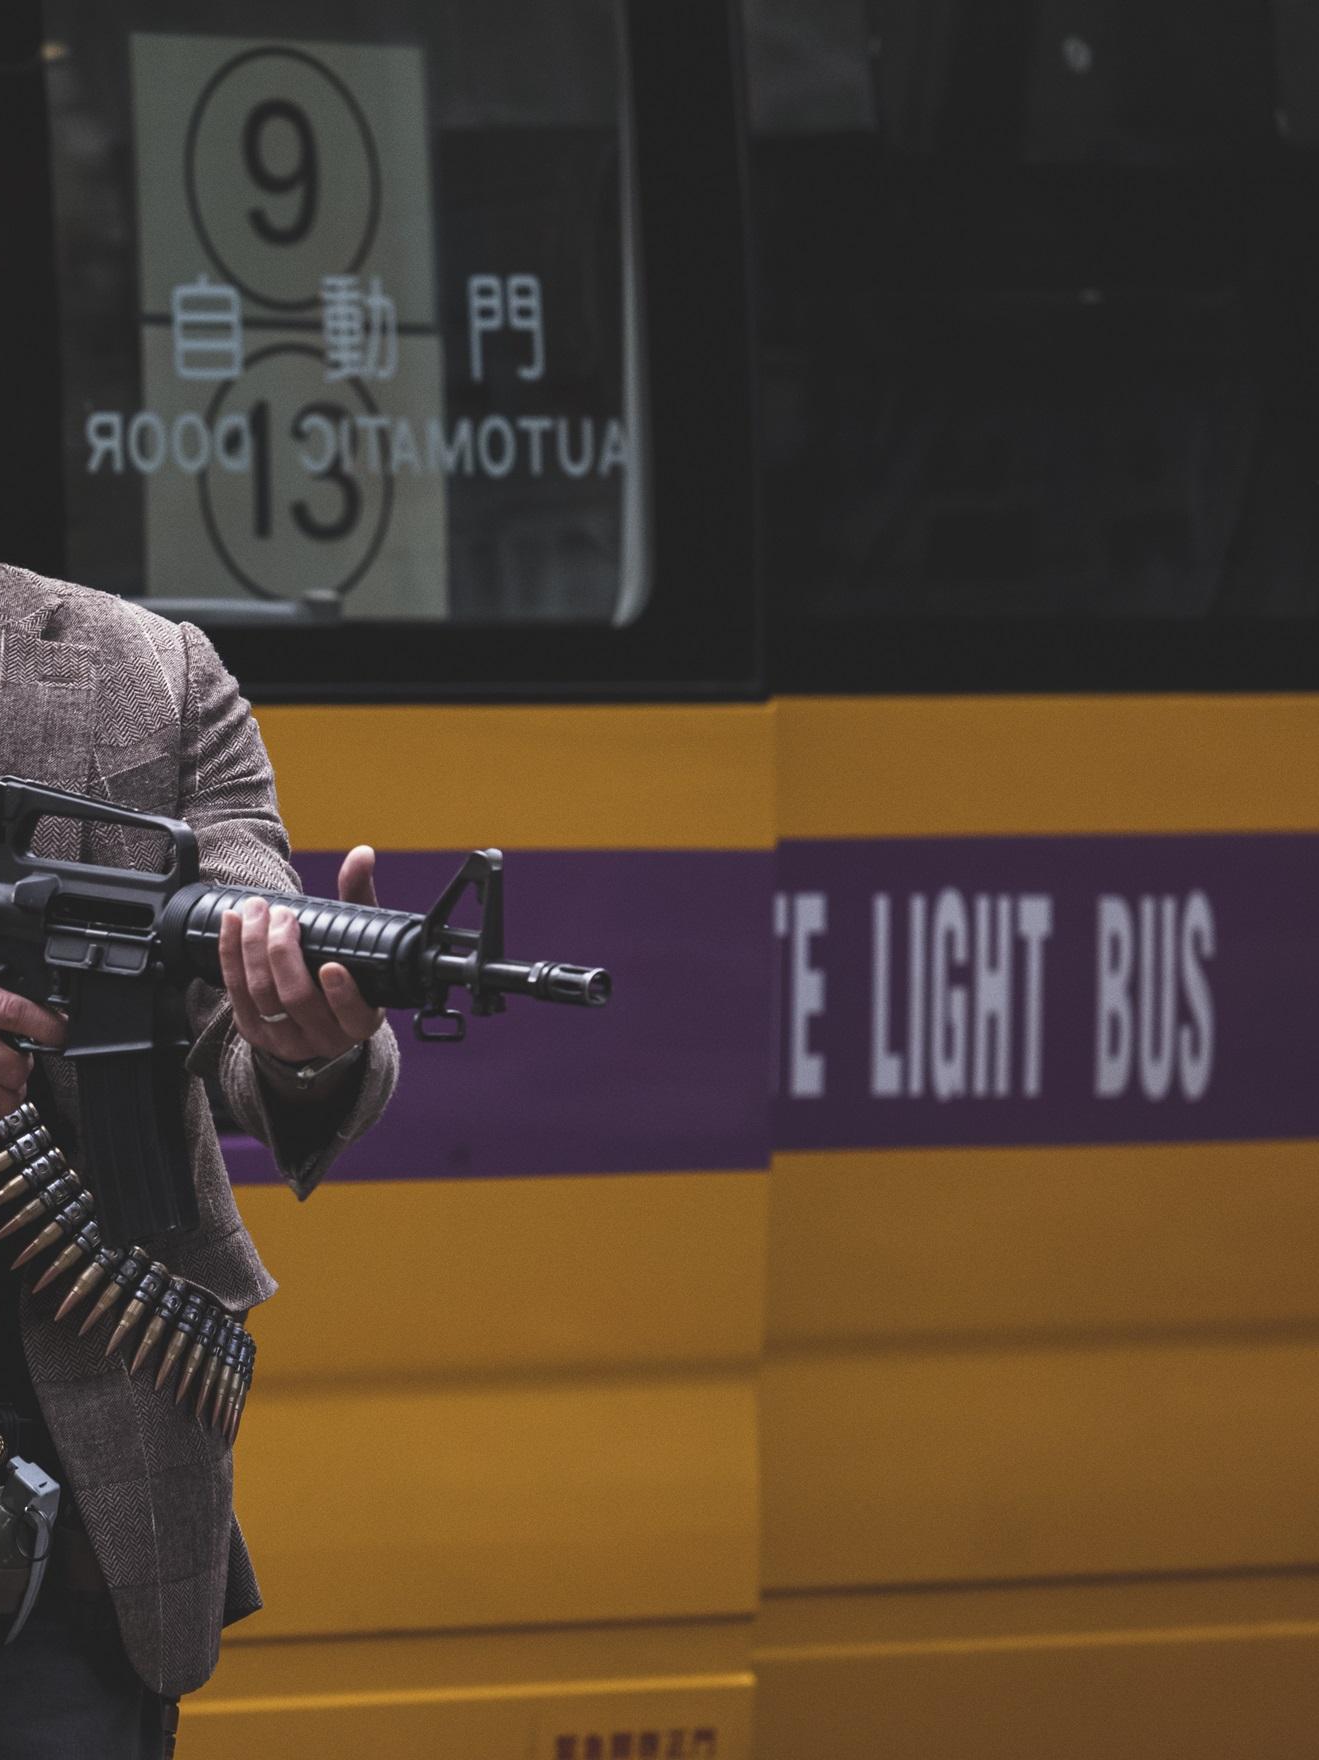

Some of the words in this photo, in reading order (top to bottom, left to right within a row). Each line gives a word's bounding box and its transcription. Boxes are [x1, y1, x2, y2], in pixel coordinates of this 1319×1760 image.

[241, 98, 321, 247] 9
[251, 398, 363, 543] 13
[774, 892, 827, 1097] E
[870, 886, 1054, 1101] LIGHT
[1095, 889, 1216, 1101] BUS
